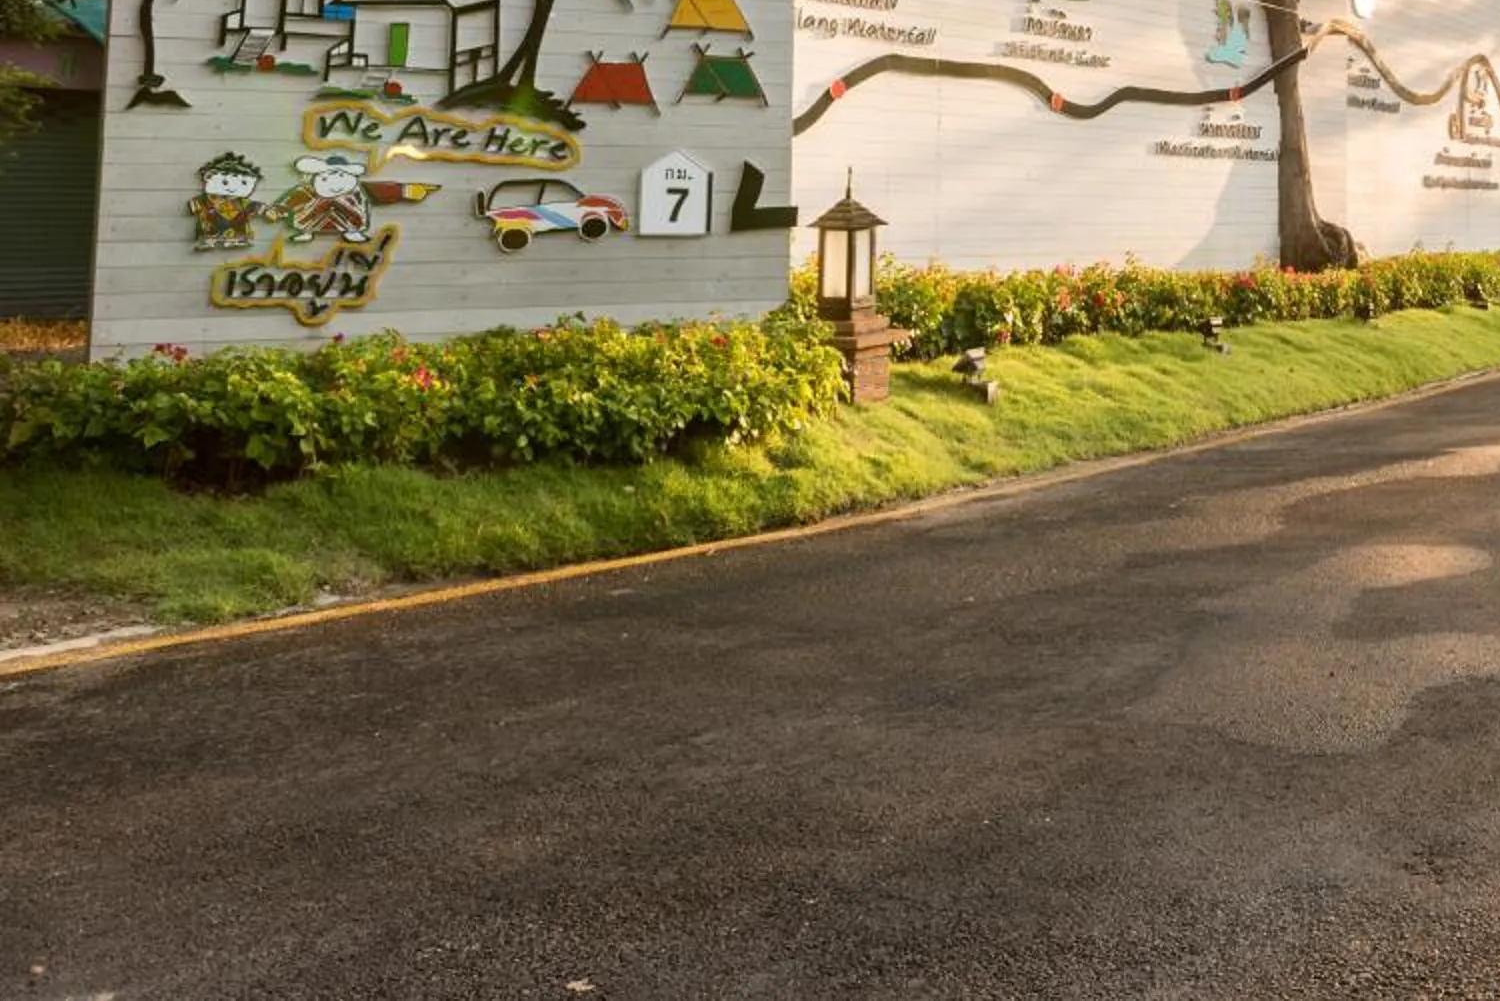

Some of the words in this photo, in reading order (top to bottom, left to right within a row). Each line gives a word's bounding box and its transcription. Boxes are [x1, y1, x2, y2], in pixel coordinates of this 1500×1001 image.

[319, 111, 382, 140] We
[397, 116, 470, 148] Are
[484, 127, 569, 160] Here
[666, 188, 690, 223] 7
